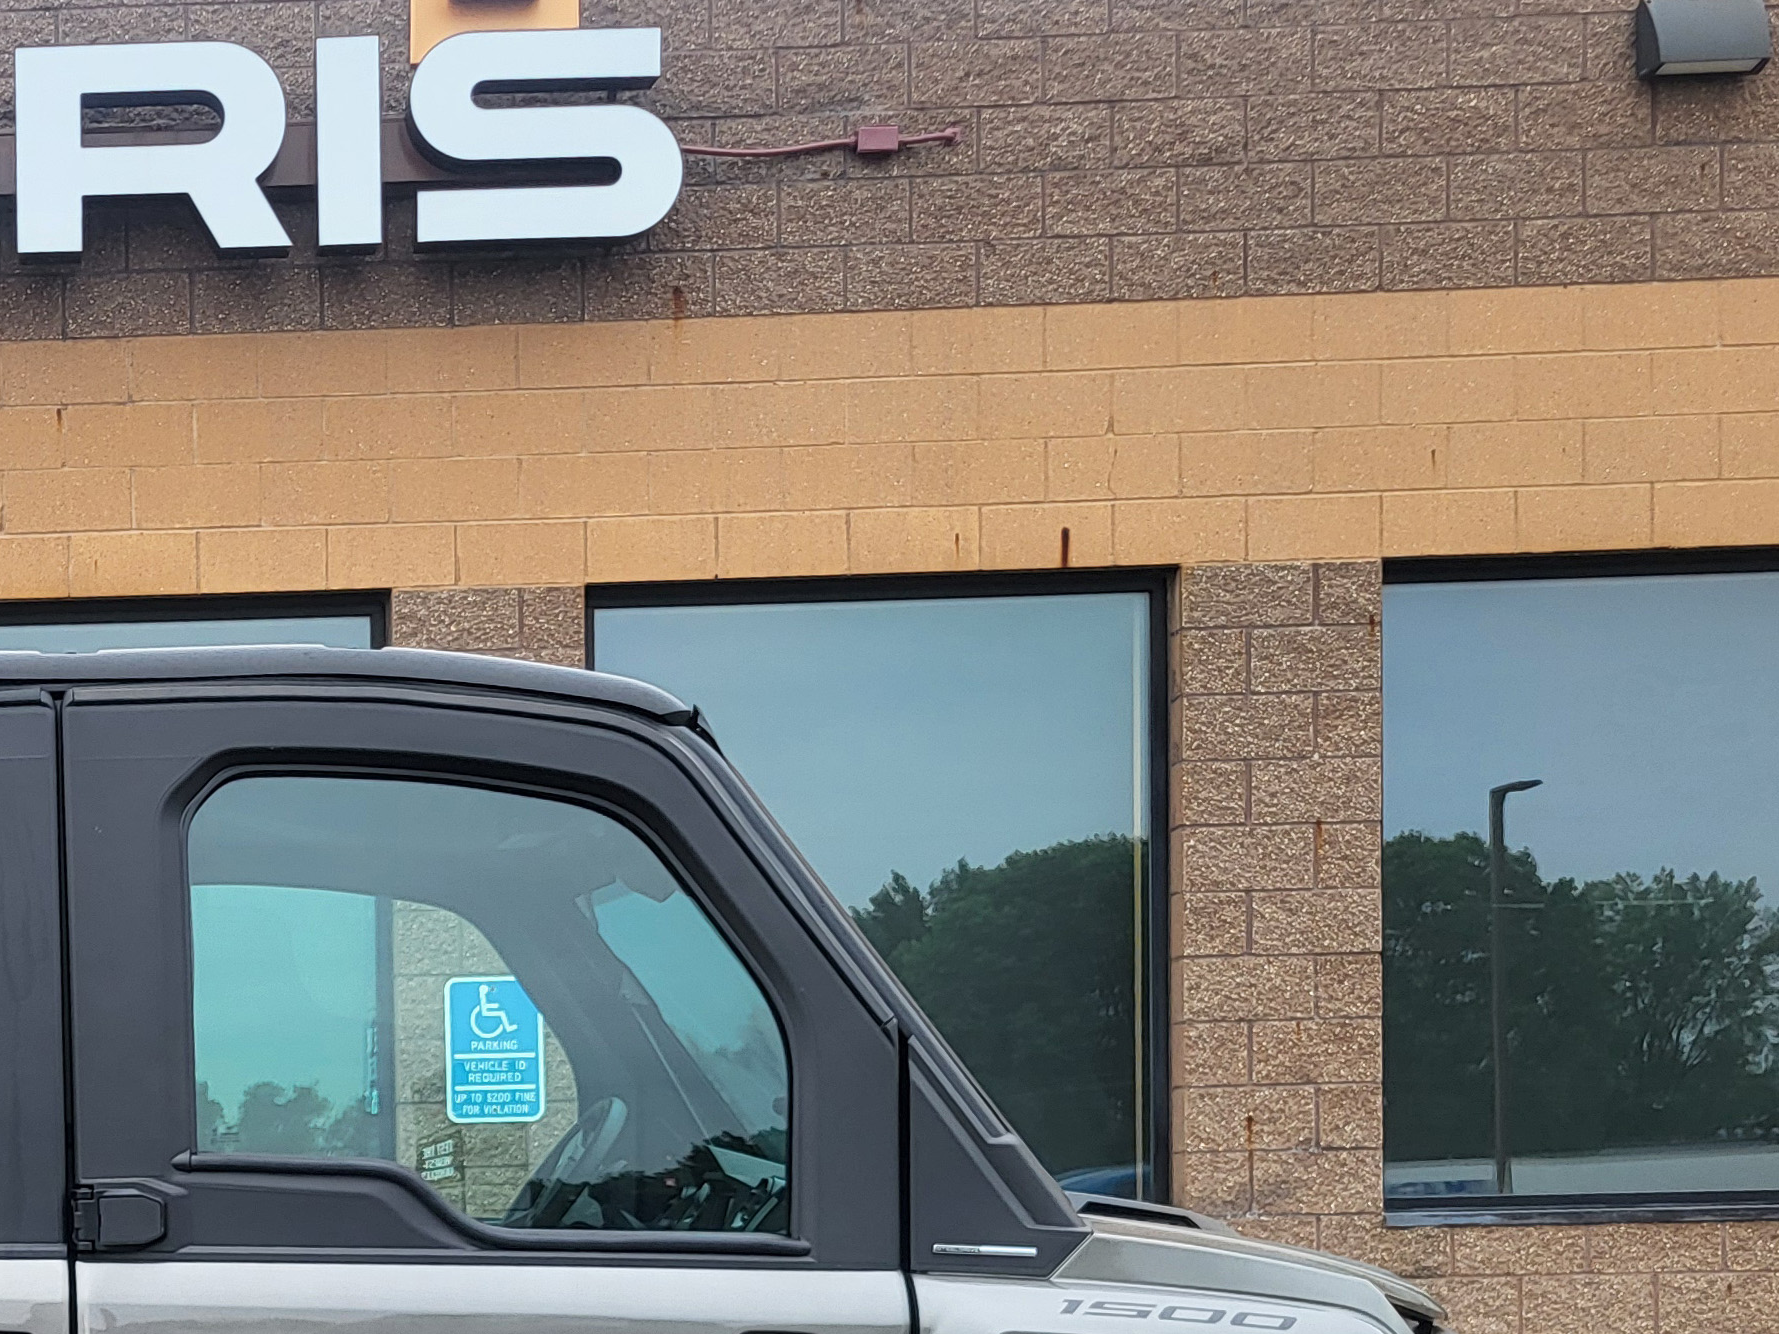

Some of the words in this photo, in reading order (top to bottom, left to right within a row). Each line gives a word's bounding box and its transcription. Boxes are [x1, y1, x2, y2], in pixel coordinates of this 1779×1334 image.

[471, 1040, 518, 1051] PARKING
[463, 1061, 509, 1071] VEHICLE
[515, 1061, 526, 1070] ID
[468, 1072, 522, 1082] REQUIRED
[454, 1094, 467, 1103] UP
[471, 1093, 482, 1102] TO
[486, 1092, 511, 1102] $200
[515, 1091, 536, 1102] FINE
[462, 1104, 480, 1115] FOR
[483, 1103, 529, 1114] VIOLATION
[1061, 1299, 1297, 1331] 1500
